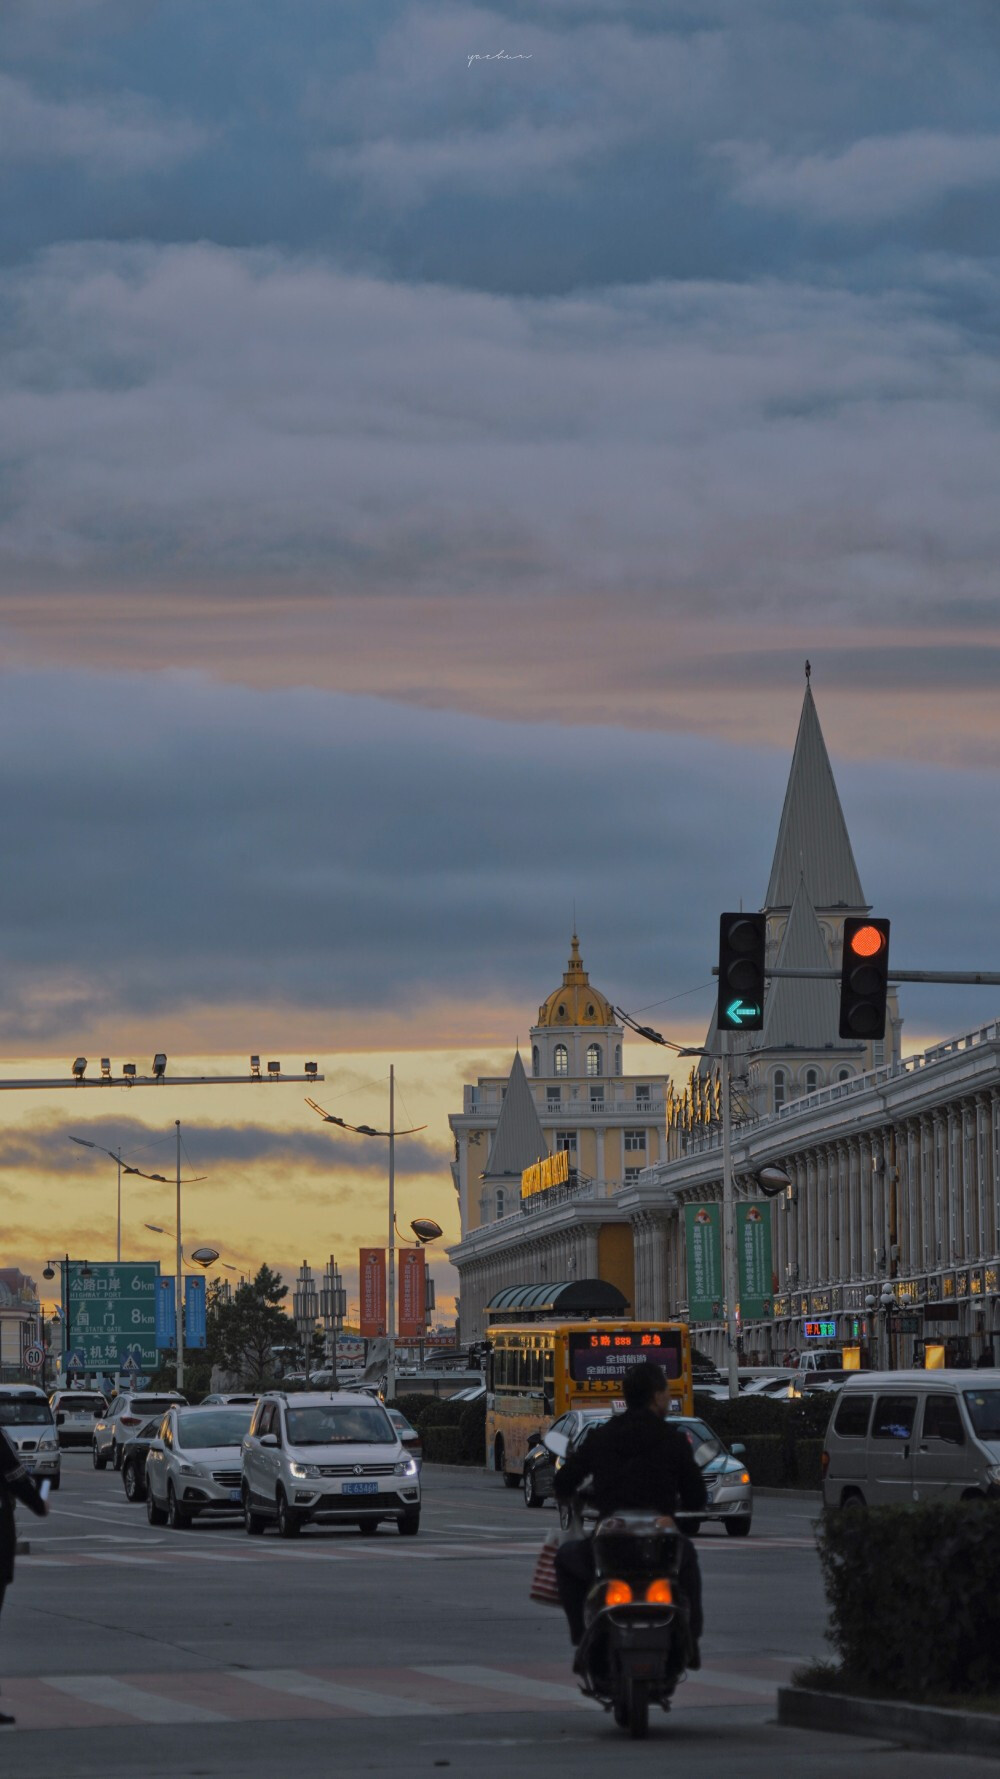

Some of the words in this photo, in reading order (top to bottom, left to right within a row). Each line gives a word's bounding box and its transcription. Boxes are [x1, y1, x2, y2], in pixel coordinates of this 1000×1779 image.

[71, 1278, 121, 1291] 公路口岸
[28, 1351, 39, 1363] 60
[606, 1354, 647, 1364] 全域旅游
